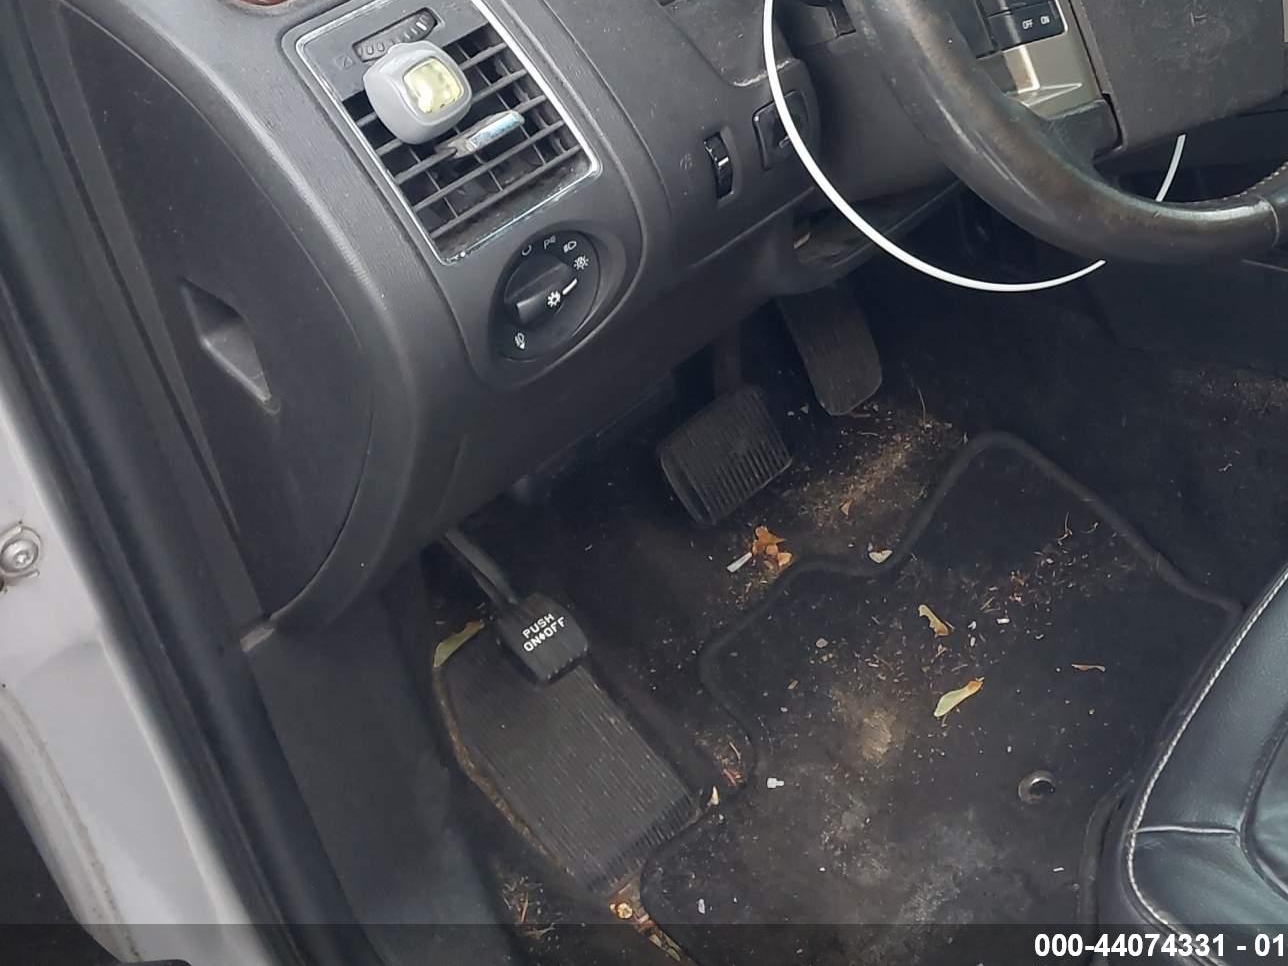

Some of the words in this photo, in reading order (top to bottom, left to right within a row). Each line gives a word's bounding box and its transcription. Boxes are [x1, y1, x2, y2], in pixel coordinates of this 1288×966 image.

[1022, 18, 1034, 30] OFF
[1040, 15, 1050, 25] ON
[522, 613, 555, 639] PUSH
